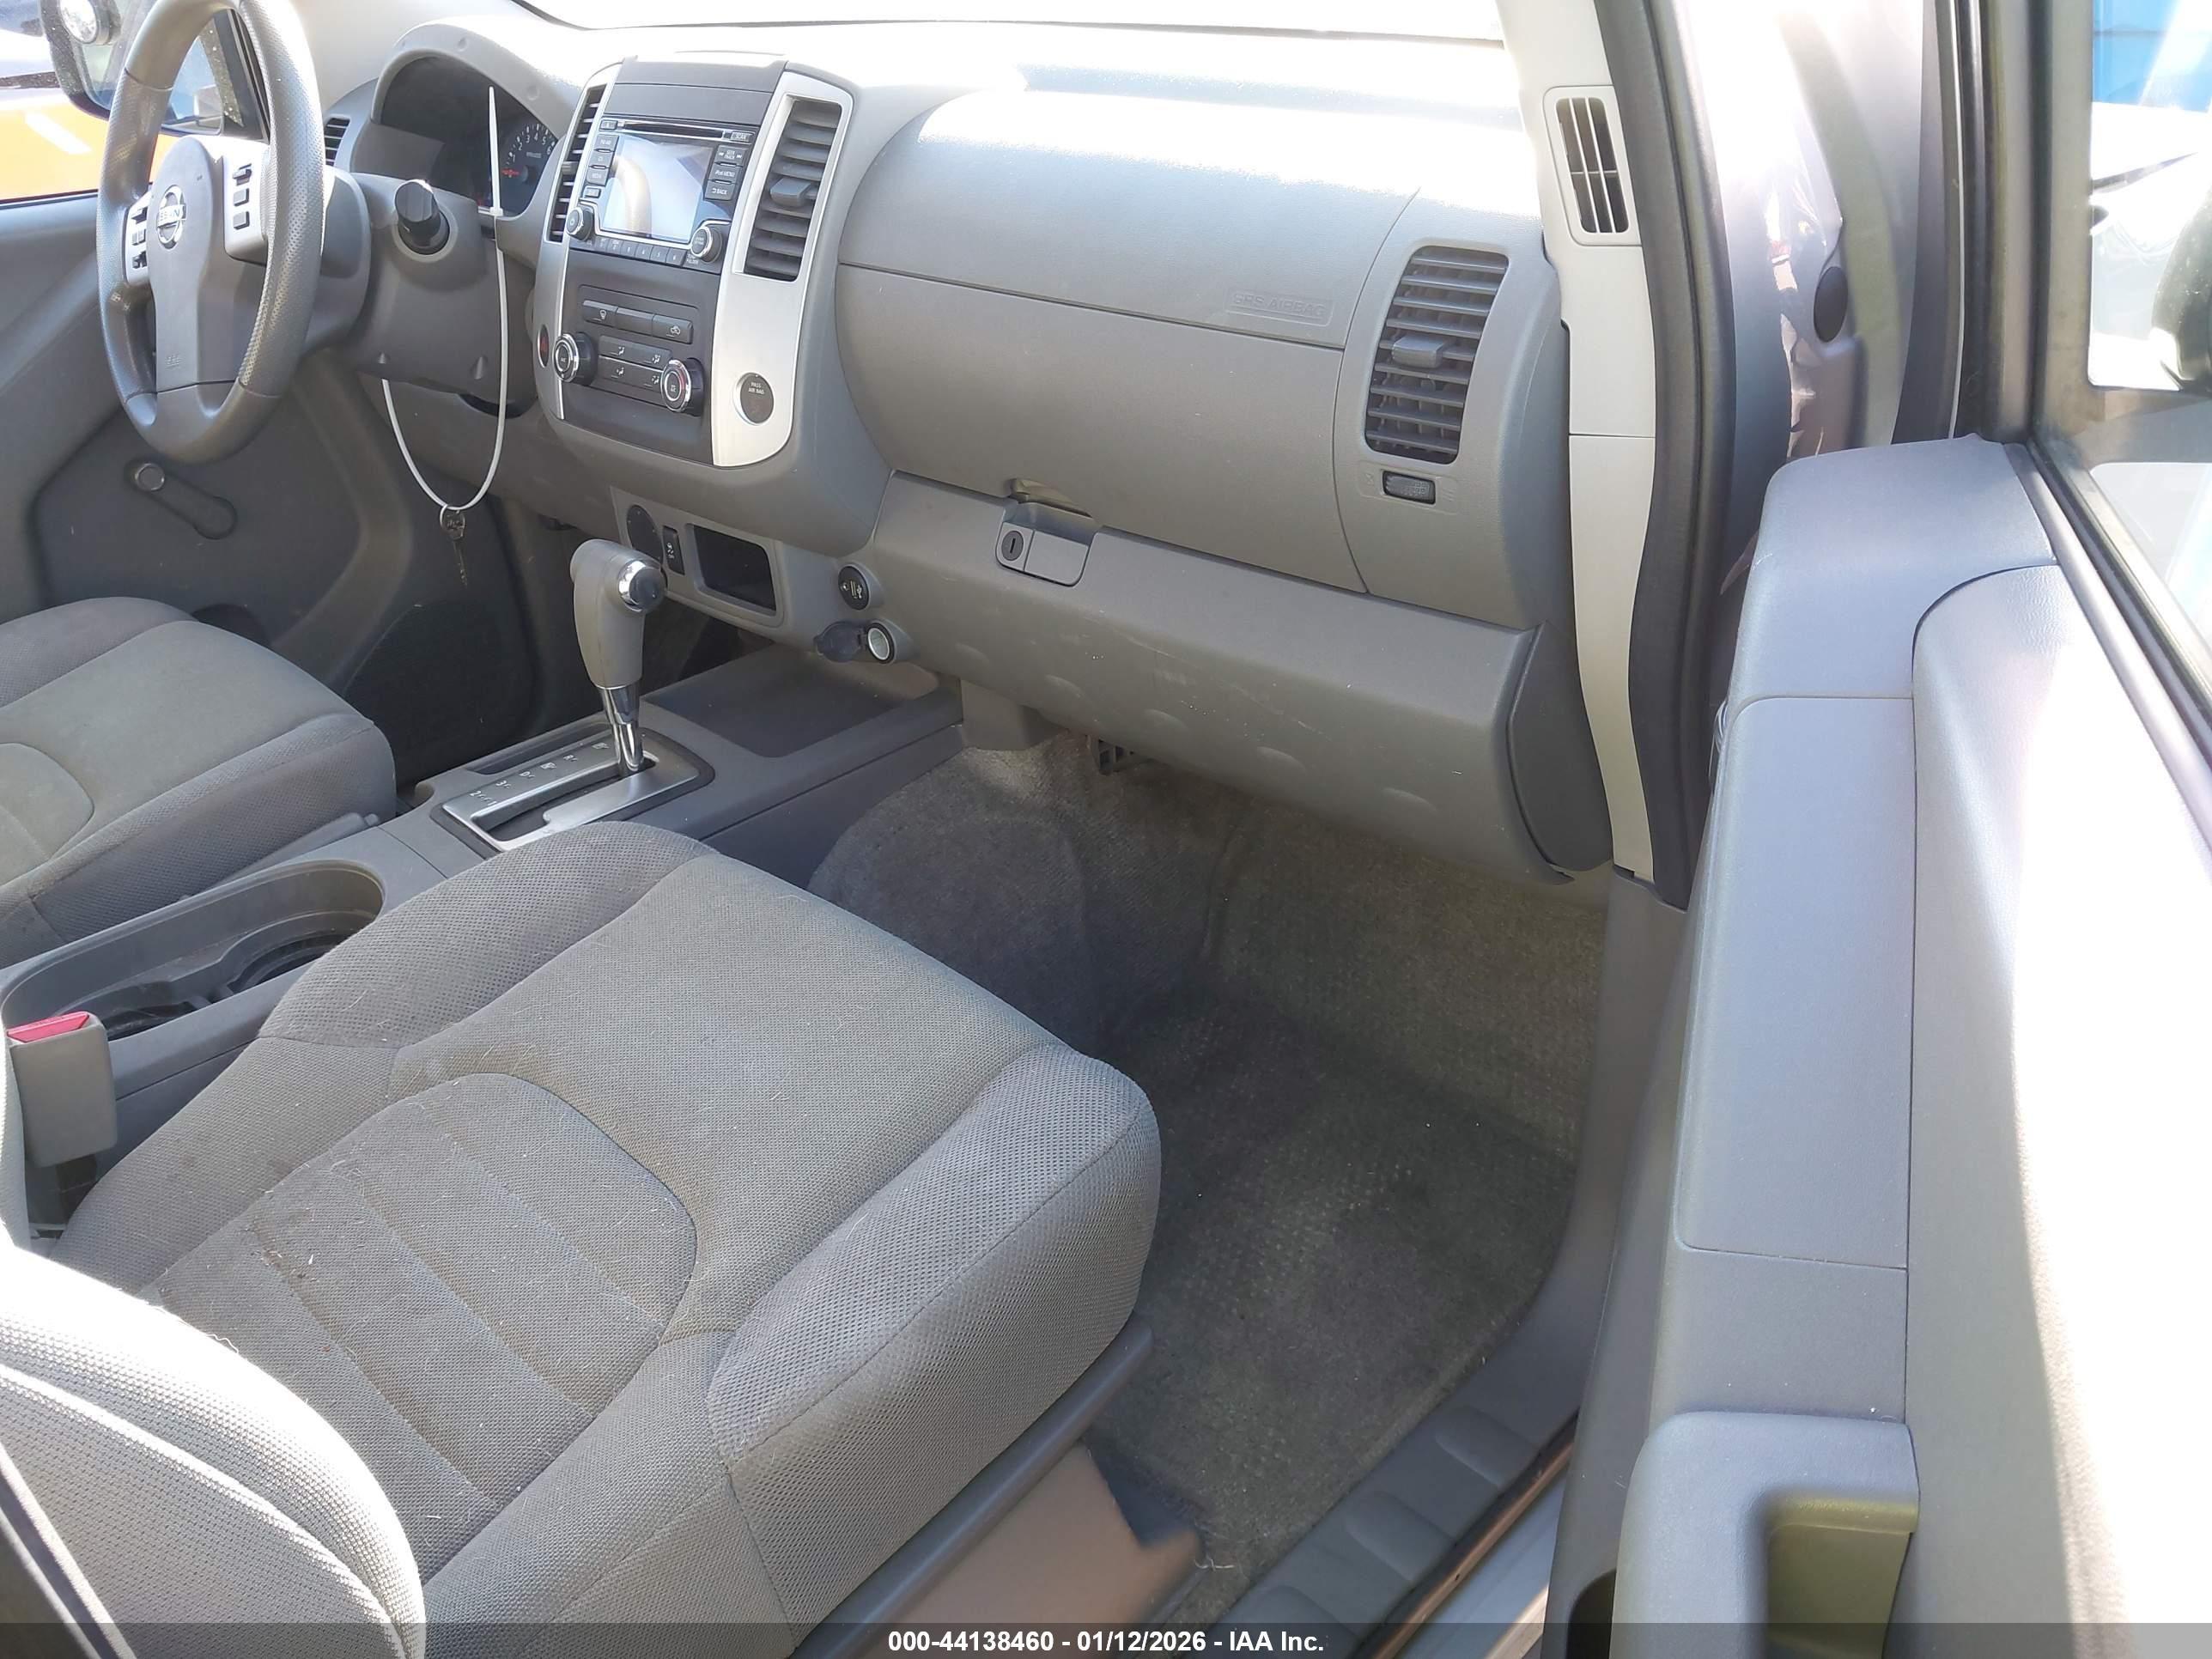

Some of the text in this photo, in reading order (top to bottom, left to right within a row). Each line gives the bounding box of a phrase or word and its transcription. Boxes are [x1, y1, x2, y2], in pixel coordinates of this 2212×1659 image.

[526, 135, 531, 143] 3
[534, 132, 538, 141] 4
[541, 137, 546, 145] 5
